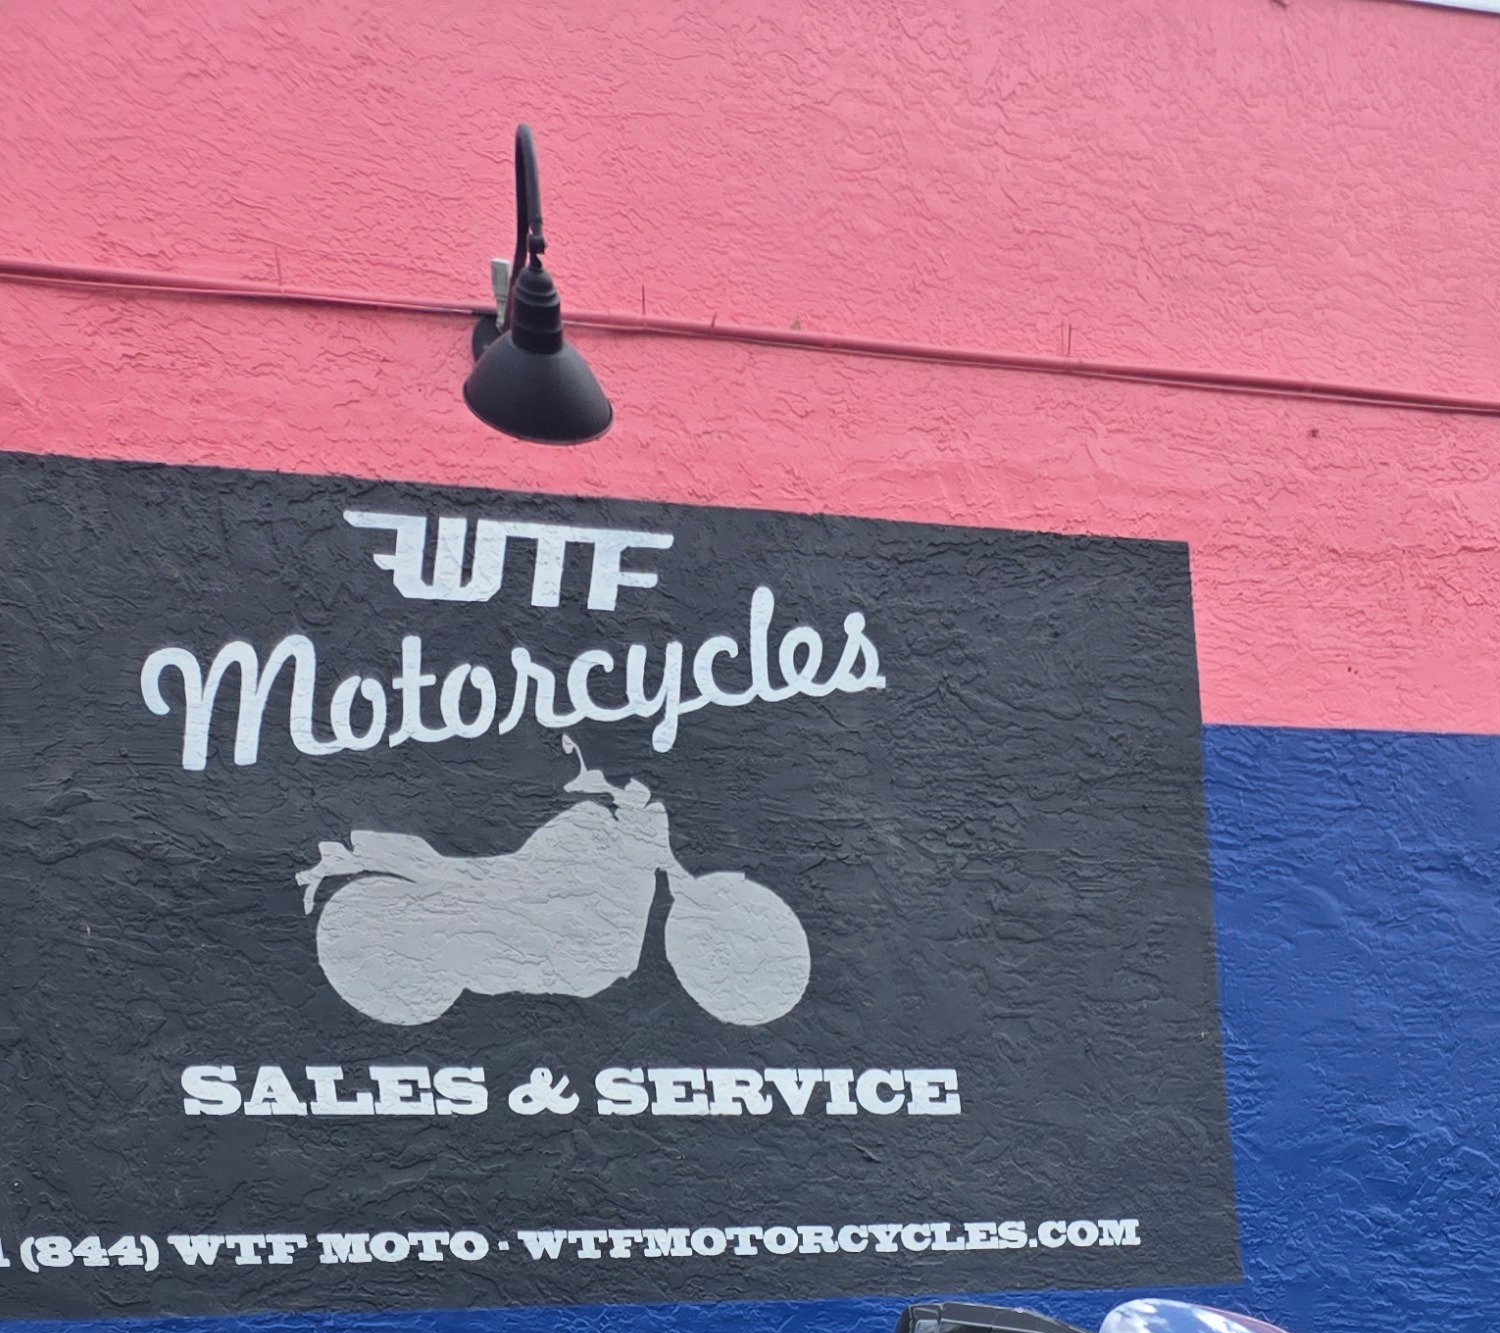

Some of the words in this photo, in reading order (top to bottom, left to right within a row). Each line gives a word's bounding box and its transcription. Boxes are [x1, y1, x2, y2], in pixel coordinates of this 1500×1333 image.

[343, 510, 674, 611] WTF
[140, 586, 886, 771] Motorcycles
[180, 1065, 489, 1116] SALES
[508, 1067, 580, 1115] &
[595, 1067, 962, 1116] SERVICE
[20, 1235, 159, 1273] (844)
[167, 1233, 308, 1266] WTF
[316, 1231, 489, 1264] MOTO
[517, 1218, 1141, 1260] WTFMOTORCYCLES.COM
